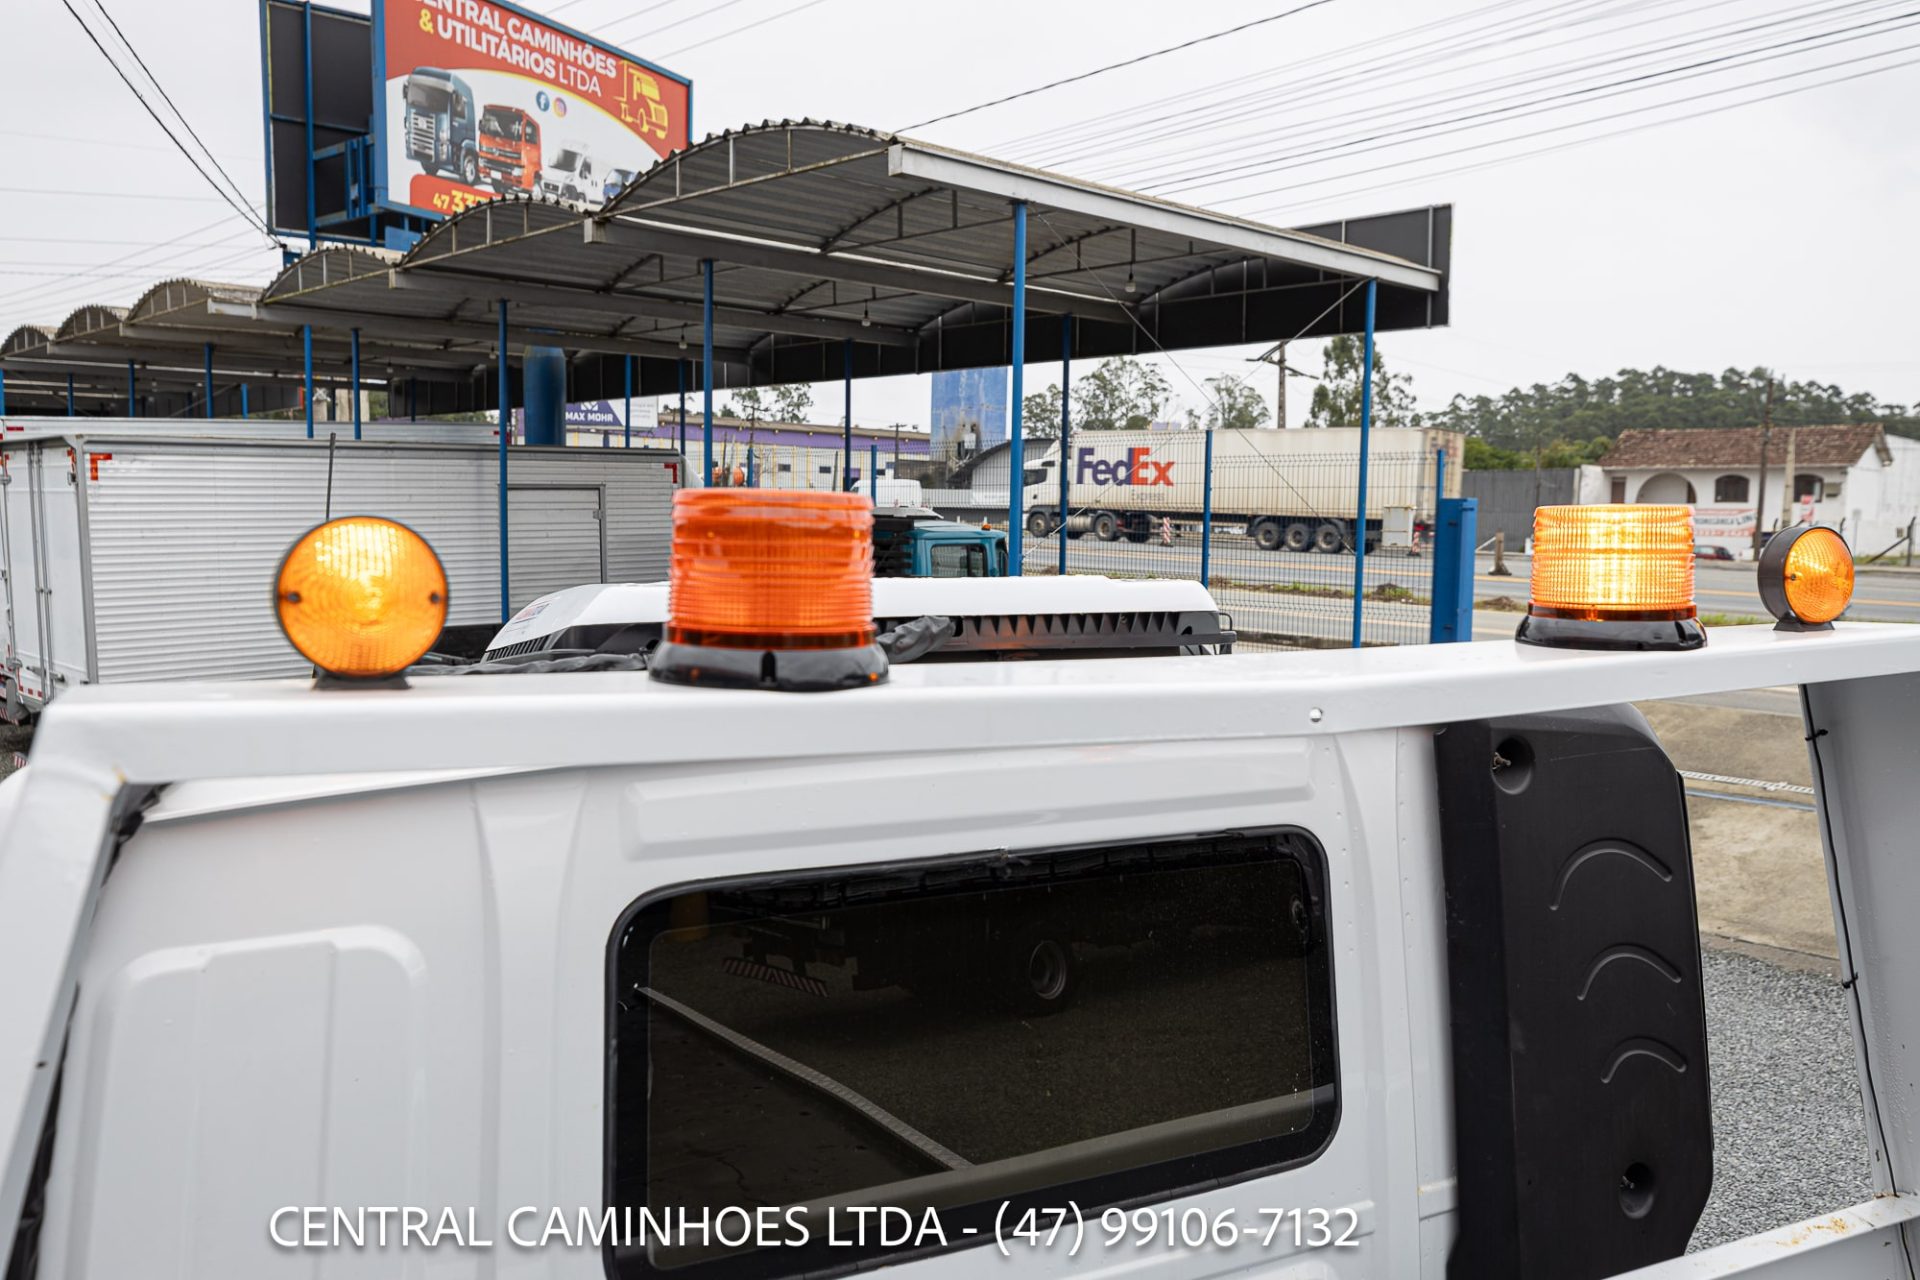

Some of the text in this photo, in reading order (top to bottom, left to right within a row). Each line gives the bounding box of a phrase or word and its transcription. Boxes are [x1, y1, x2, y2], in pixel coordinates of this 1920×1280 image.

[414, 0, 617, 78] NTRAL CAMINHÕES
[419, 8, 602, 98] & UTILITÁRIOS LTDA
[433, 192, 449, 210] 47
[565, 411, 614, 423] MAX MOHR
[1076, 447, 1175, 486] FedEx
